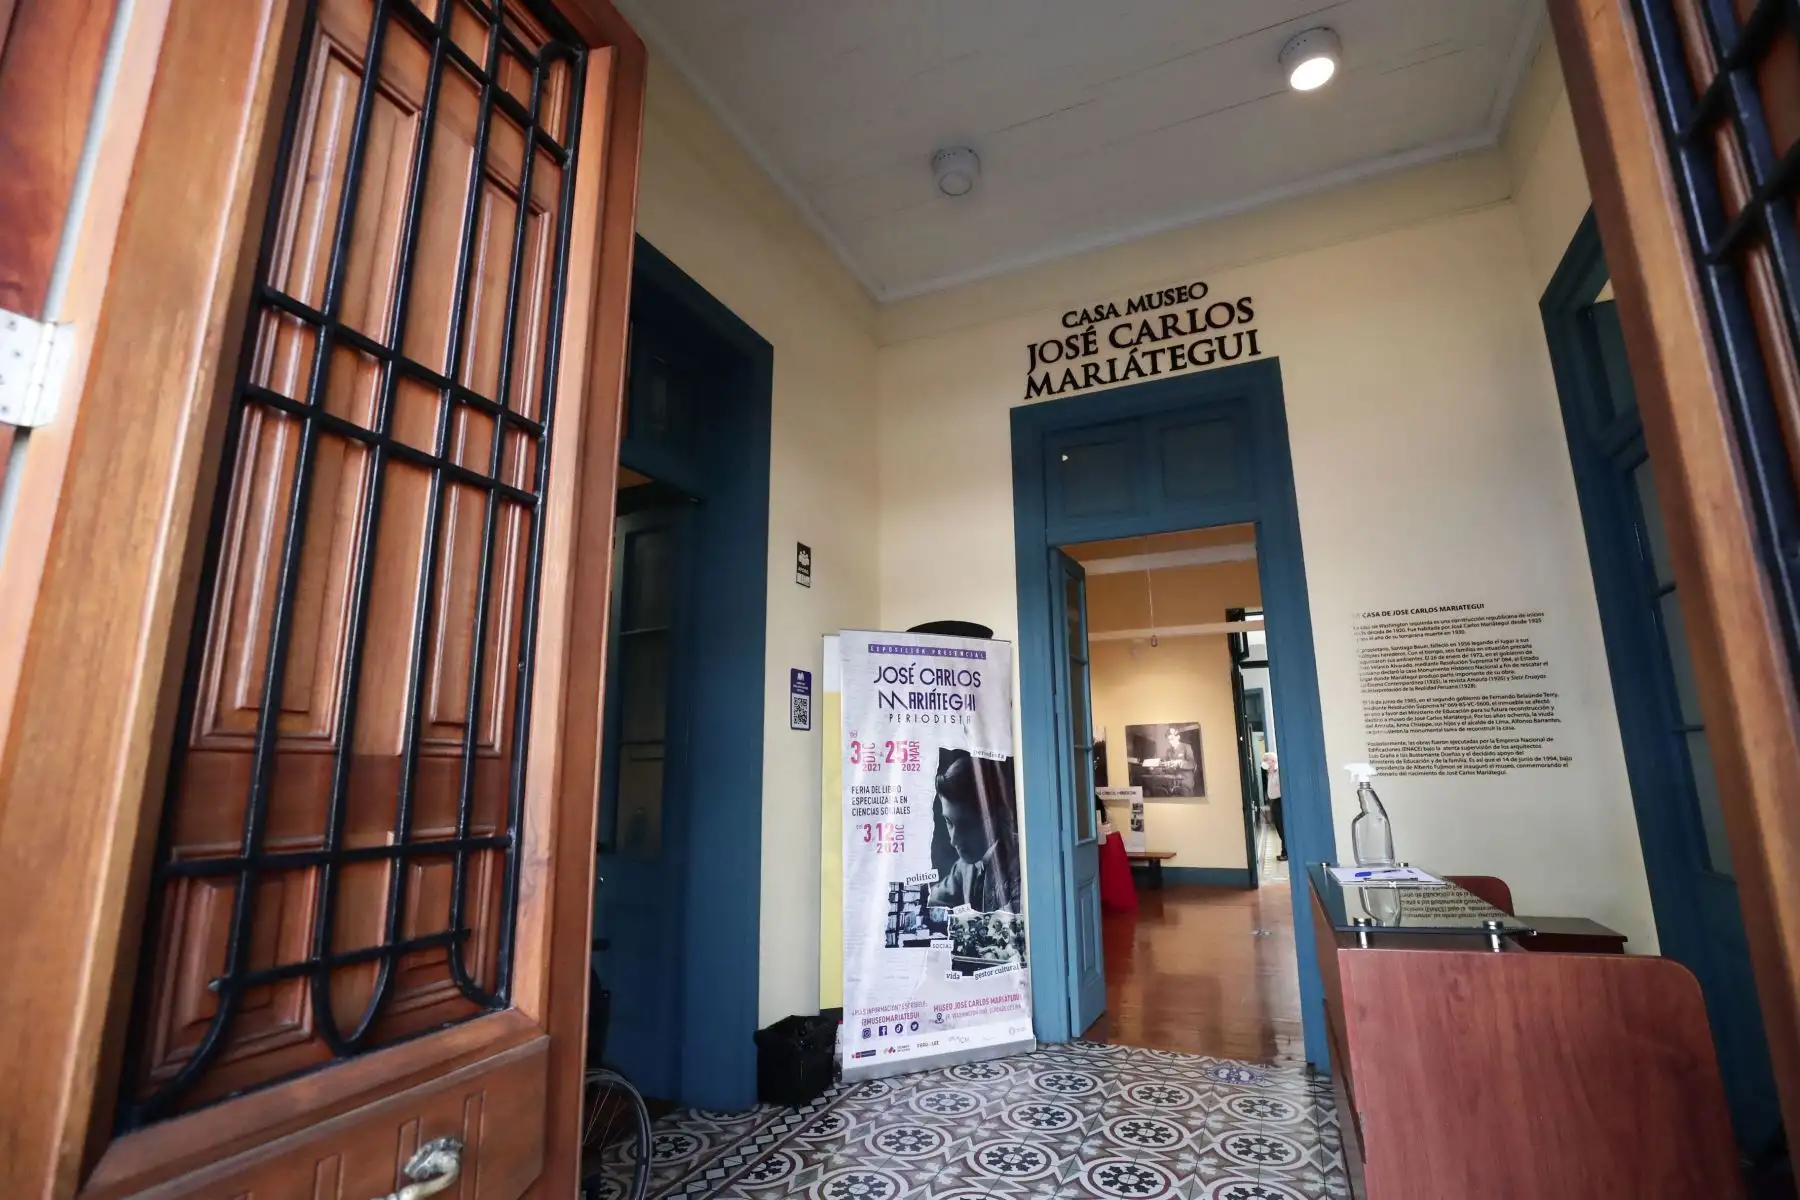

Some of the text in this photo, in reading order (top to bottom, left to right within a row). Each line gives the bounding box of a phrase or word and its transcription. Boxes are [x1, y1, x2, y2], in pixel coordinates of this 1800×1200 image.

[1062, 281, 1208, 329] CASA MUSEO
[1027, 296, 1254, 375] JOSÉ CARLOS
[1024, 329, 1261, 399] MARIÁTEGUI
[873, 662, 981, 688] JOSÉ CARLOS
[1455, 670, 1485, 678] importante
[878, 687, 976, 712] MARIÁTEGUI
[889, 713, 971, 724] PERIODISTA
[850, 741, 861, 764] 3
[885, 740, 908, 764] 25
[908, 740, 920, 762] MAR
[863, 763, 881, 772] 2021
[902, 763, 921, 772] 2022
[851, 785, 870, 795] FERIA
[871, 785, 881, 794] DEL
[900, 795, 908, 804] EN
[851, 807, 879, 817] CIENCIAS
[863, 823, 871, 843] 3
[946, 972, 960, 980] vida
[974, 964, 1020, 980] gestor cultural
[934, 1003, 953, 1012] MUSEO
[968, 997, 989, 1007] CARLOS
